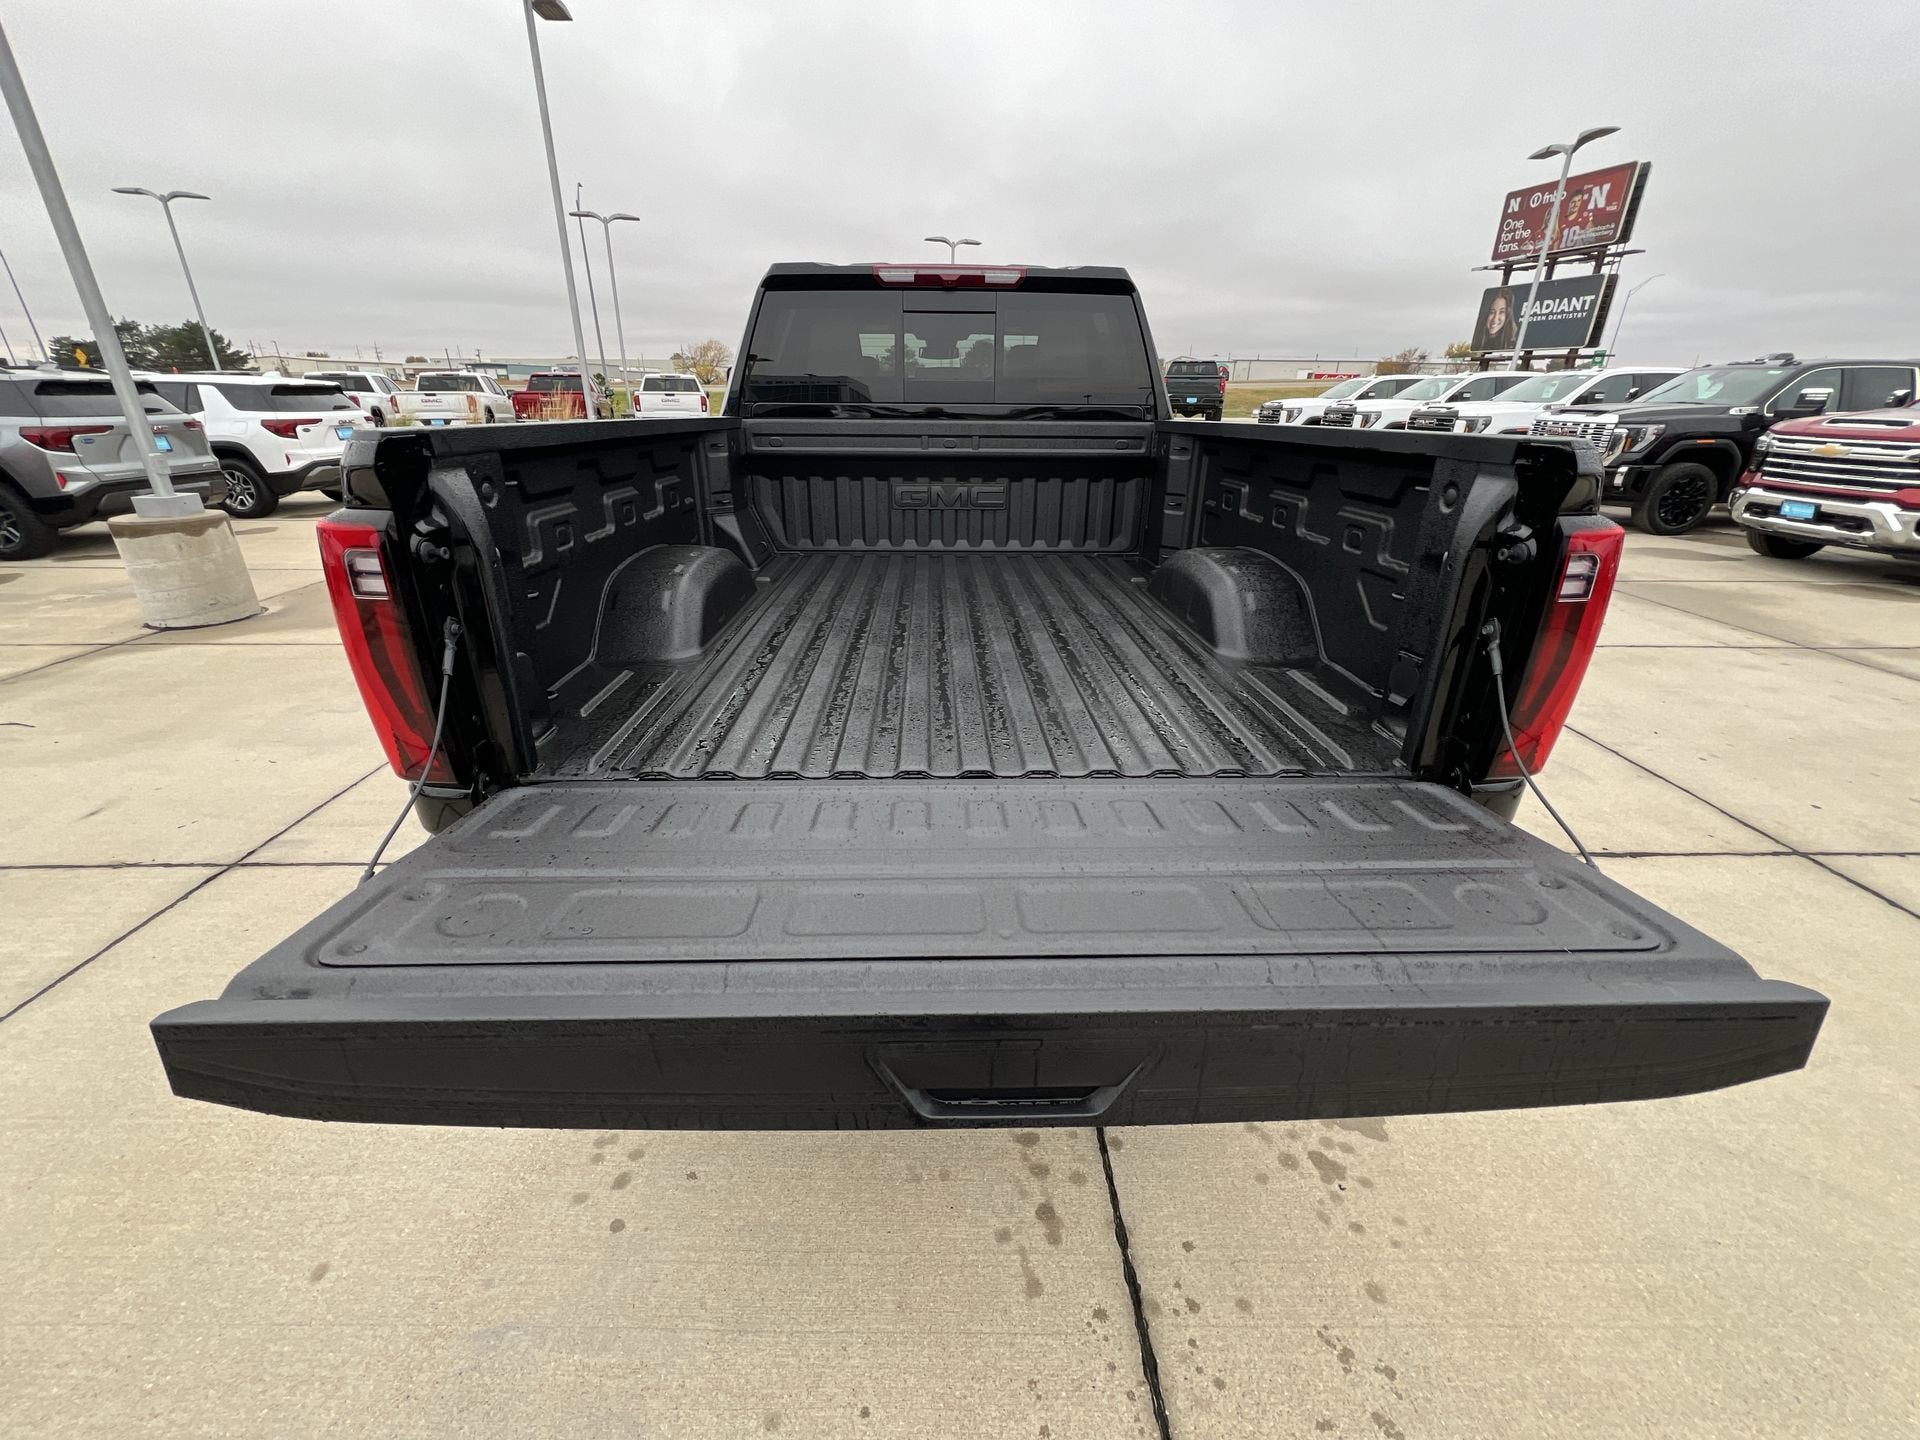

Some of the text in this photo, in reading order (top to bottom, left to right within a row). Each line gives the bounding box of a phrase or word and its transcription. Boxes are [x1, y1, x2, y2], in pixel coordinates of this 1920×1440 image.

[1507, 196, 1522, 213] N
[1503, 219, 1525, 231] One
[1500, 228, 1531, 242] for the
[1548, 311, 1588, 321] DENTISTRY
[893, 485, 1005, 509] GMC
